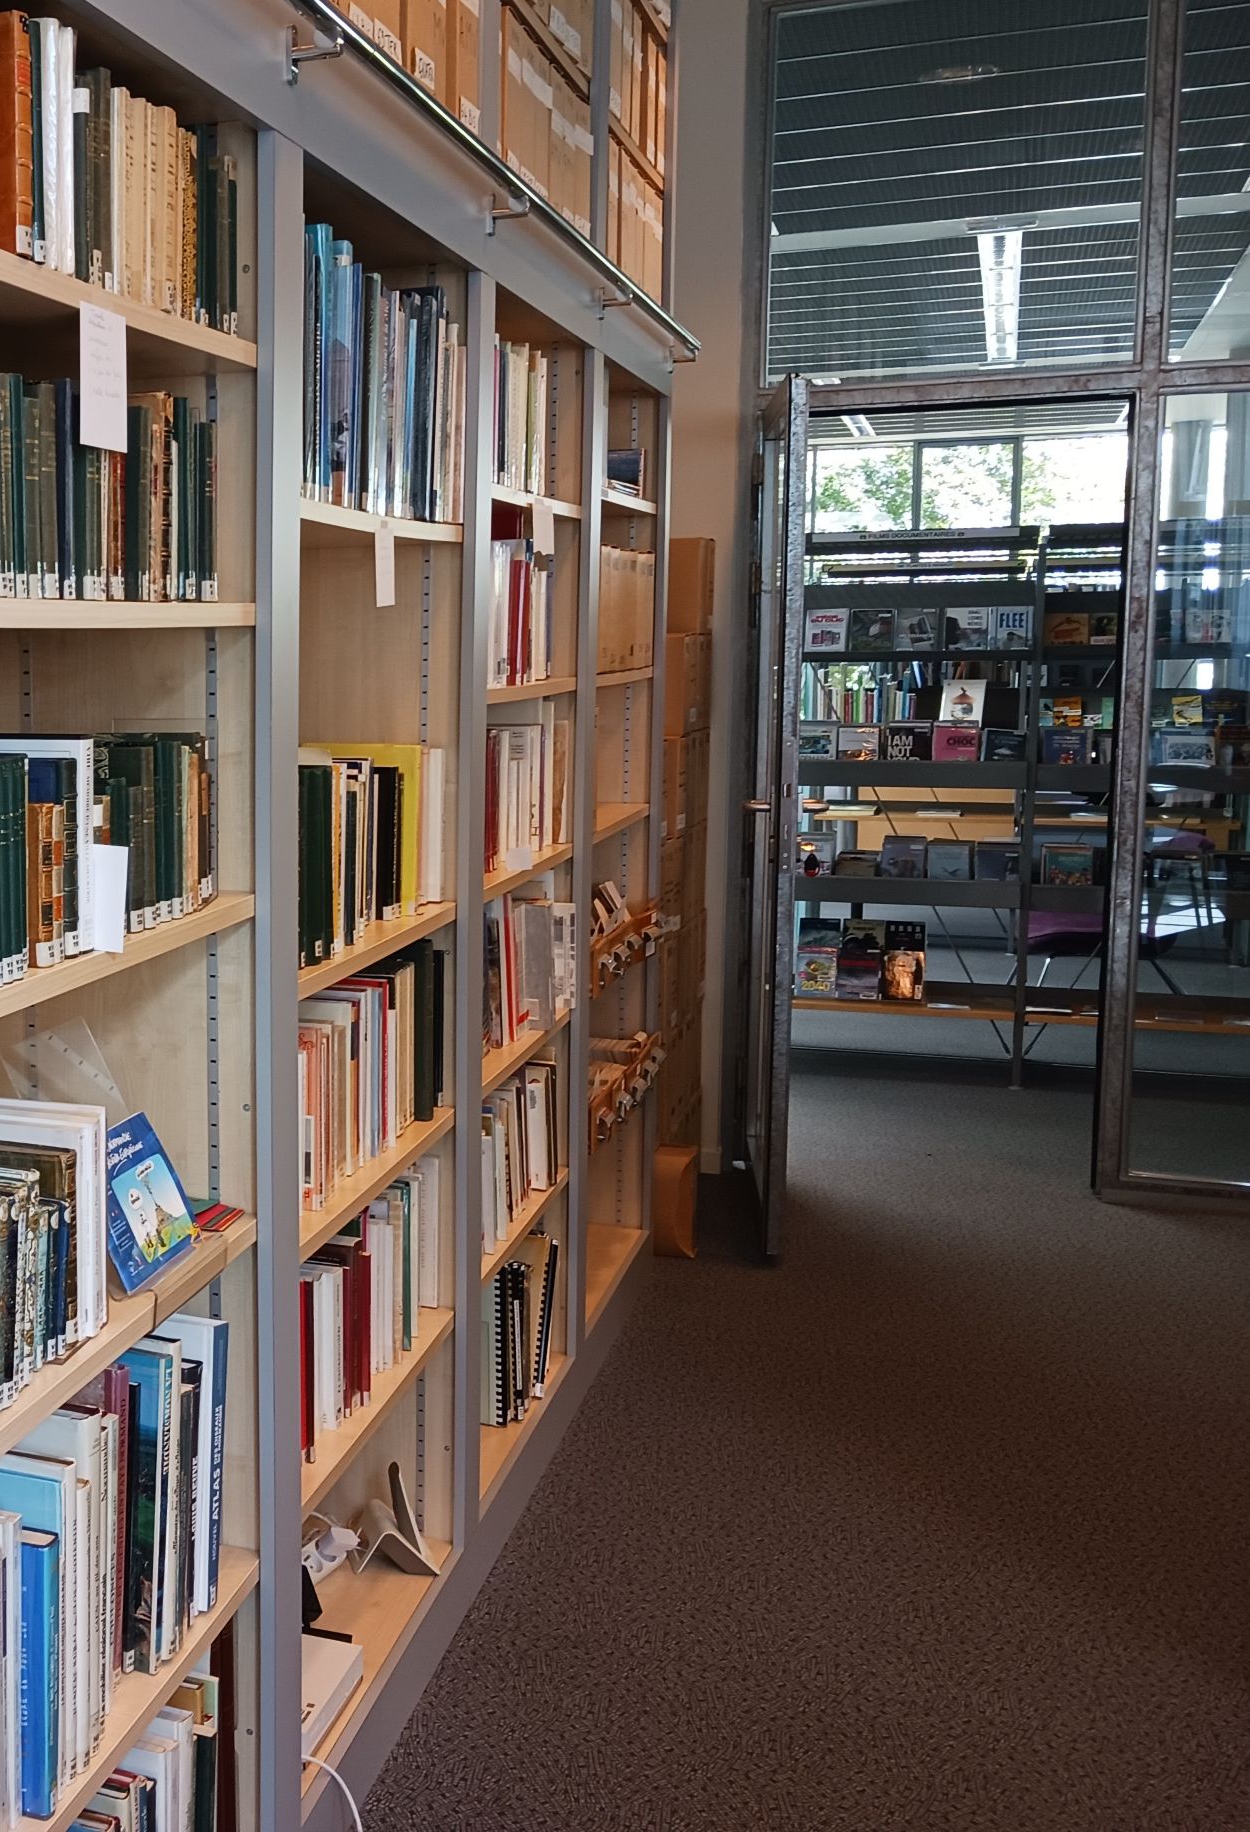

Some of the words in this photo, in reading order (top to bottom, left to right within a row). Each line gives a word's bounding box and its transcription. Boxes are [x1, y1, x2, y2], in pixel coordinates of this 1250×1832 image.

[1000, 612, 1024, 628] FLEE
[892, 736, 913, 746] AM
[946, 737, 975, 745] CHOC
[888, 746, 912, 756] NOT
[801, 980, 831, 993] 2040
[210, 1468, 220, 1520] ATLAS
